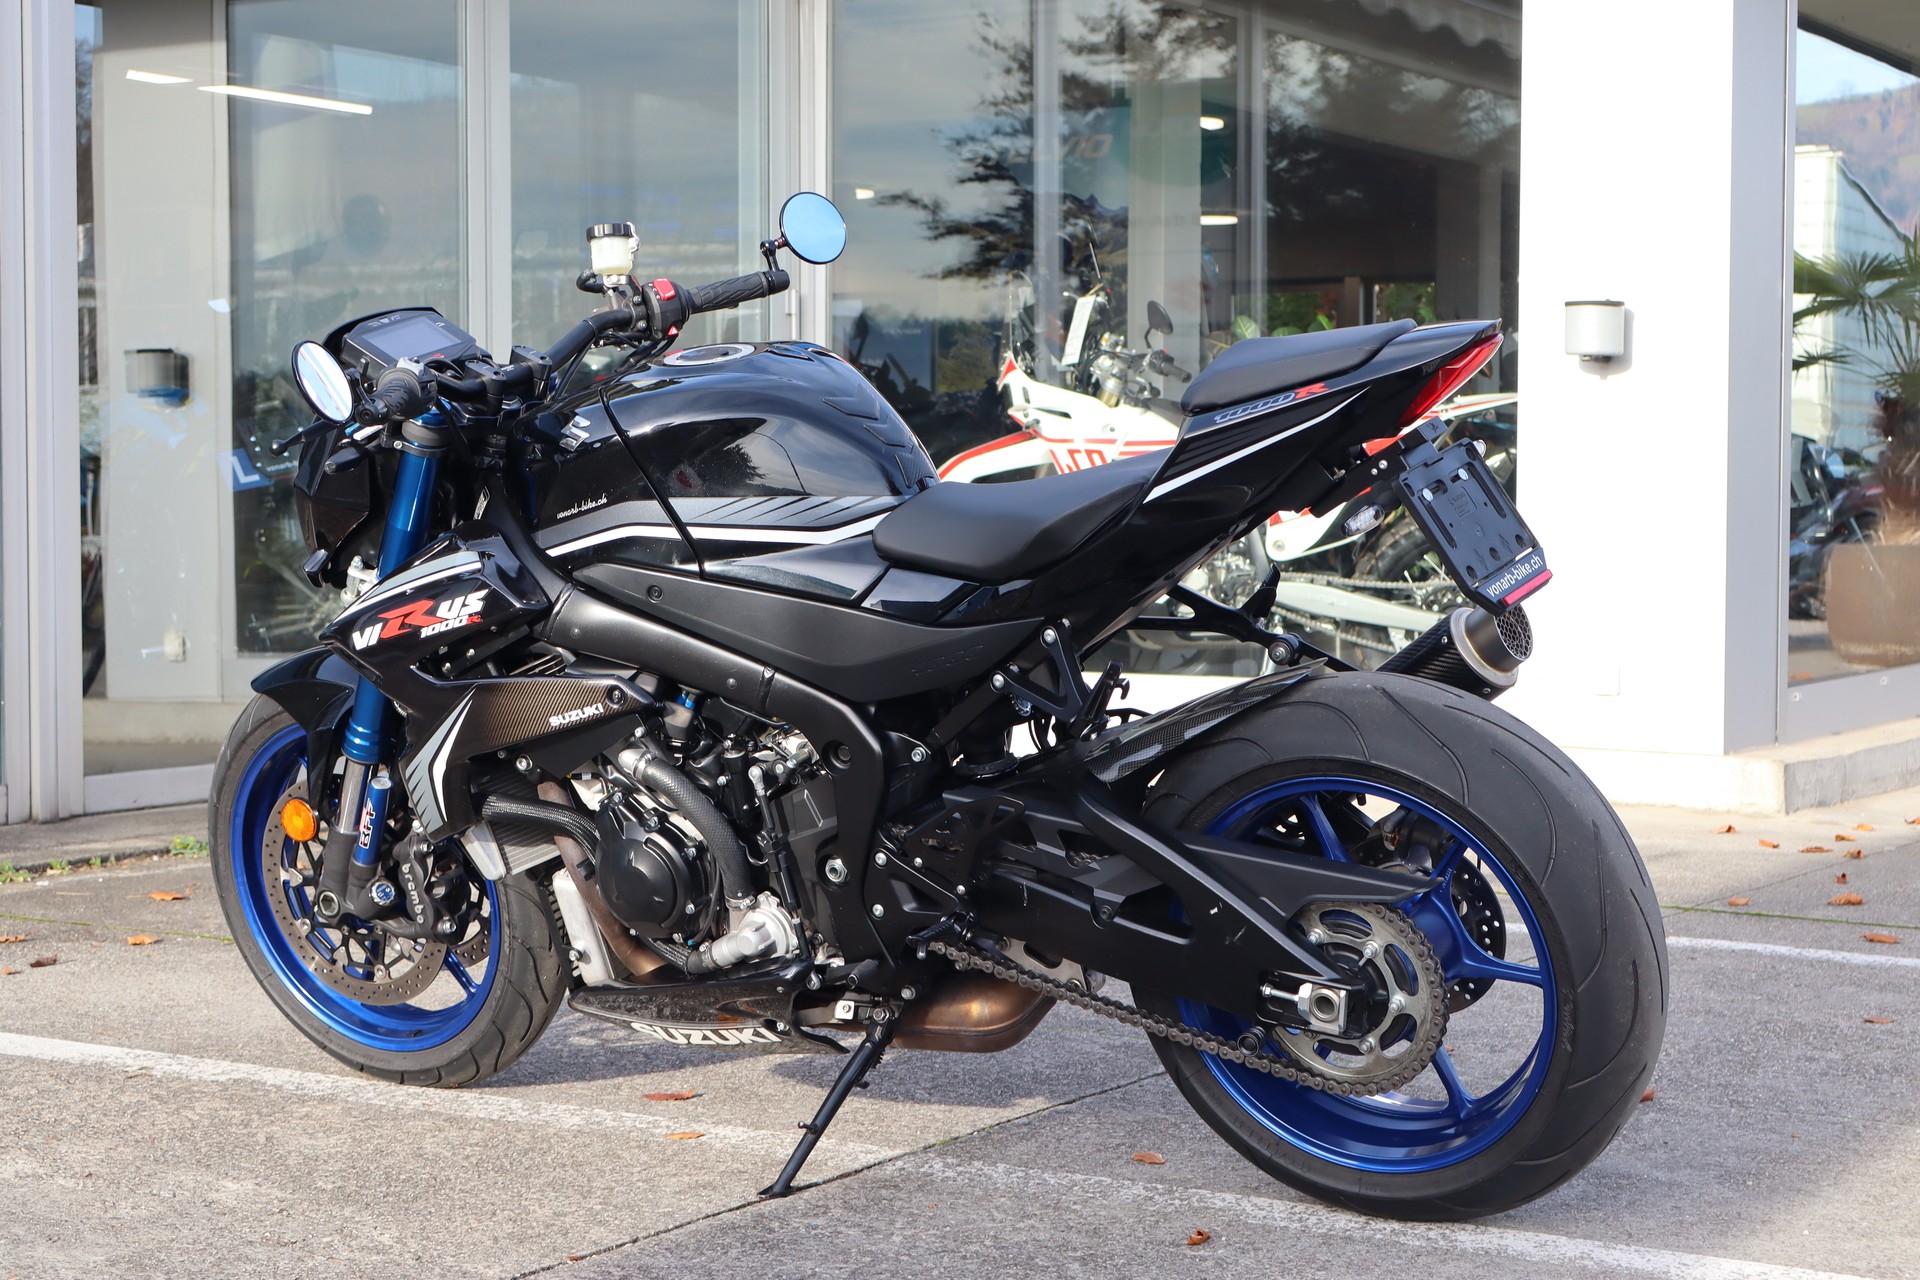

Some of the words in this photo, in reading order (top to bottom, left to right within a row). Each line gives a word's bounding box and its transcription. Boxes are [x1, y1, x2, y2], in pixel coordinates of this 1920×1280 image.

[1214, 382, 1329, 423] 1000R
[556, 493, 608, 519] vonarb-bike.ch
[1486, 555, 1543, 597] vonarb-bike.ch
[352, 589, 489, 650] VIRUS
[420, 614, 484, 639] 1000R
[549, 702, 604, 727] SUZUKI
[401, 863, 425, 924] brembo
[630, 1022, 782, 1045] SUZUKI
